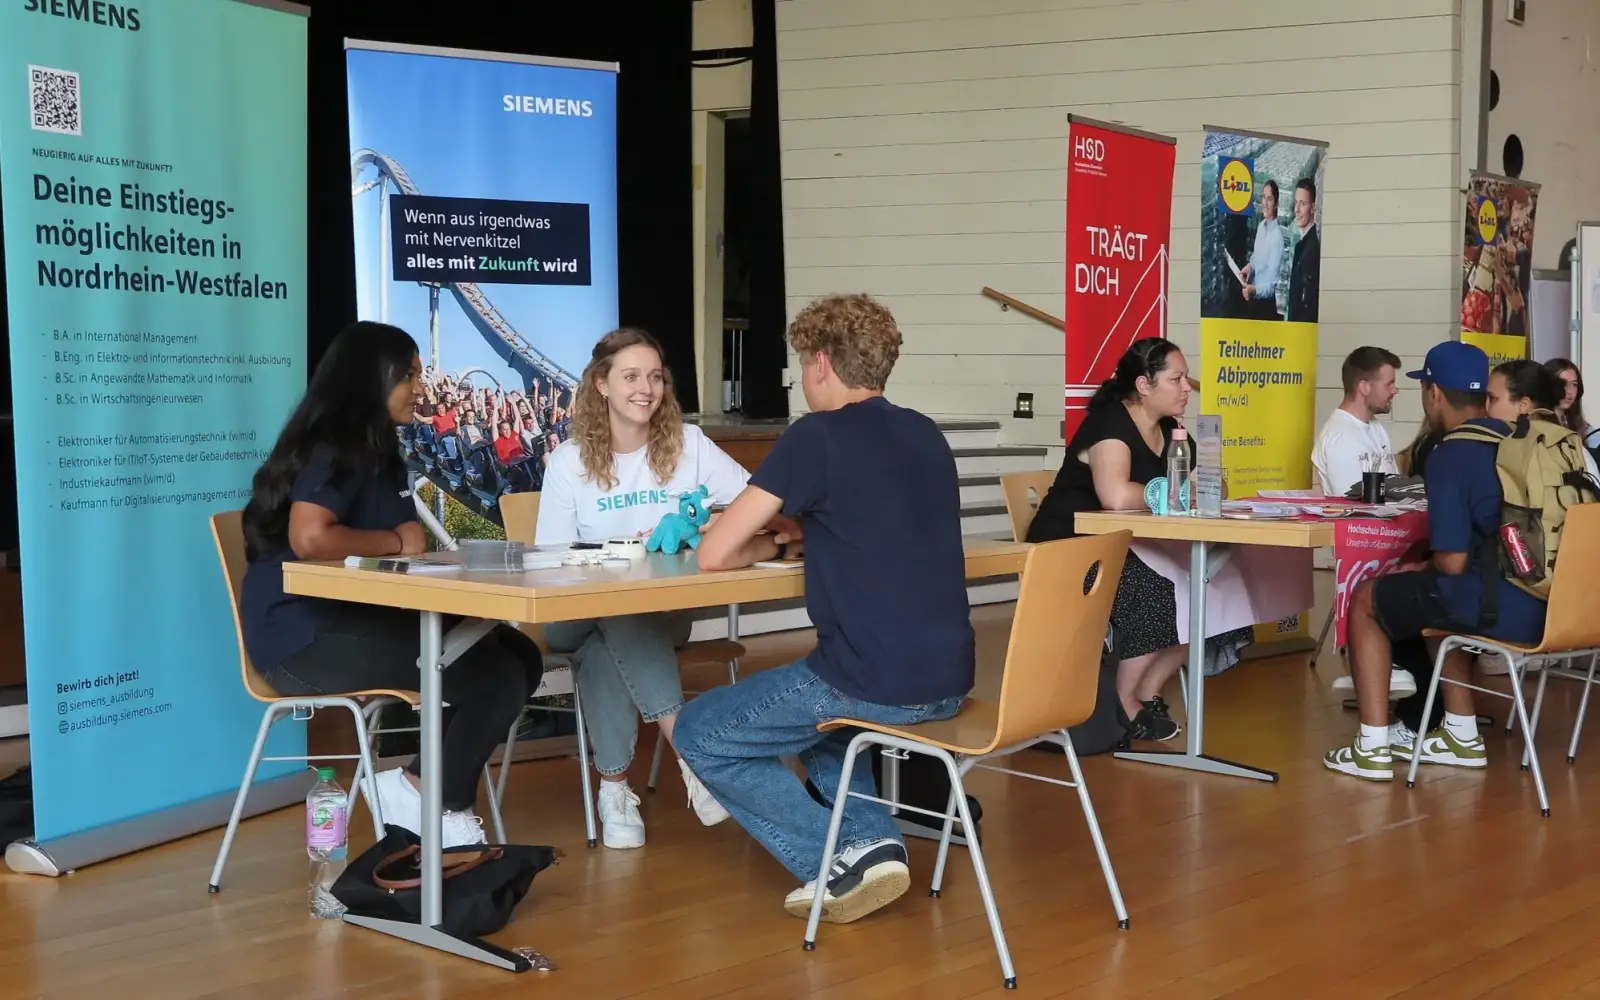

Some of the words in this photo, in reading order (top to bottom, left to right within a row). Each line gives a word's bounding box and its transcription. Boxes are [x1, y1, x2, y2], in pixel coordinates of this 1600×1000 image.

[24, 0, 141, 31] SIEMENS
[503, 95, 593, 117] SIEMENS
[1075, 136, 1105, 162] HSD
[32, 148, 76, 161] NEUGIERIG
[78, 153, 94, 163] AUF
[96, 155, 120, 166] ALLES
[122, 158, 135, 168] MIT
[136, 160, 173, 173] ZUKUNFT?
[1223, 175, 1250, 194] LIDL
[33, 174, 112, 208] Deine
[120, 183, 235, 224] Einstiegs-
[404, 208, 446, 225] Wenn
[450, 214, 475, 226] aus
[479, 211, 551, 231] irgendwas
[35, 218, 215, 258] möglichkeiten
[222, 233, 242, 259] in
[405, 231, 428, 246] mit
[434, 231, 521, 249] Nervenkitzel
[1086, 225, 1148, 262] TRÄGT
[407, 253, 444, 269] alles
[448, 255, 476, 270] mit
[479, 256, 540, 272] Zukunft
[543, 258, 578, 273] wird
[37, 260, 288, 299] Nordrhein-Westfalen
[1075, 263, 1119, 296] DICH
[53, 329, 70, 341] B.A.
[73, 330, 82, 341] in
[85, 331, 141, 342] International
[143, 333, 197, 346] Management
[54, 351, 82, 365] B.Eng.
[85, 351, 94, 363] in
[97, 351, 131, 363] Elektro-
[133, 353, 148, 363] und
[150, 352, 230, 364] Informationstechnik
[248, 355, 291, 368] Ausbildung
[1218, 340, 1285, 360] Teilnehmer
[55, 372, 76, 384] B.Sc.
[79, 373, 88, 383] in
[90, 372, 145, 386] Angewandte
[147, 373, 195, 384] Mathematik
[197, 373, 213, 384] und
[215, 373, 253, 384] Informatik
[1217, 365, 1303, 388] Abiprogramm
[56, 393, 77, 405] B.Sc.
[80, 394, 88, 404] in
[91, 393, 203, 407] Wirtschaftsingenieurwesen
[1217, 393, 1248, 407] (m/w/d)
[58, 435, 112, 447] Elektroniker
[115, 434, 127, 445] für
[129, 431, 227, 446] Automatisierungstechnik
[1221, 436, 1237, 447] eine
[1239, 435, 1265, 447] Benefits:
[59, 456, 112, 468] Elektroniker
[114, 455, 126, 466] für
[186, 452, 198, 462] der
[59, 475, 142, 490] Industriekaufmann
[61, 498, 108, 511] Kaufmann
[111, 496, 123, 507] für
[125, 489, 236, 508] Digitalisierungsmanagement
[597, 489, 668, 512] SIEMENS
[57, 678, 92, 694] Bewirb
[94, 674, 114, 688] dich
[115, 670, 139, 687] jetzt!
[69, 686, 155, 712] siemens_ausbildung
[71, 702, 172, 732] ausbildung.siemens.com
